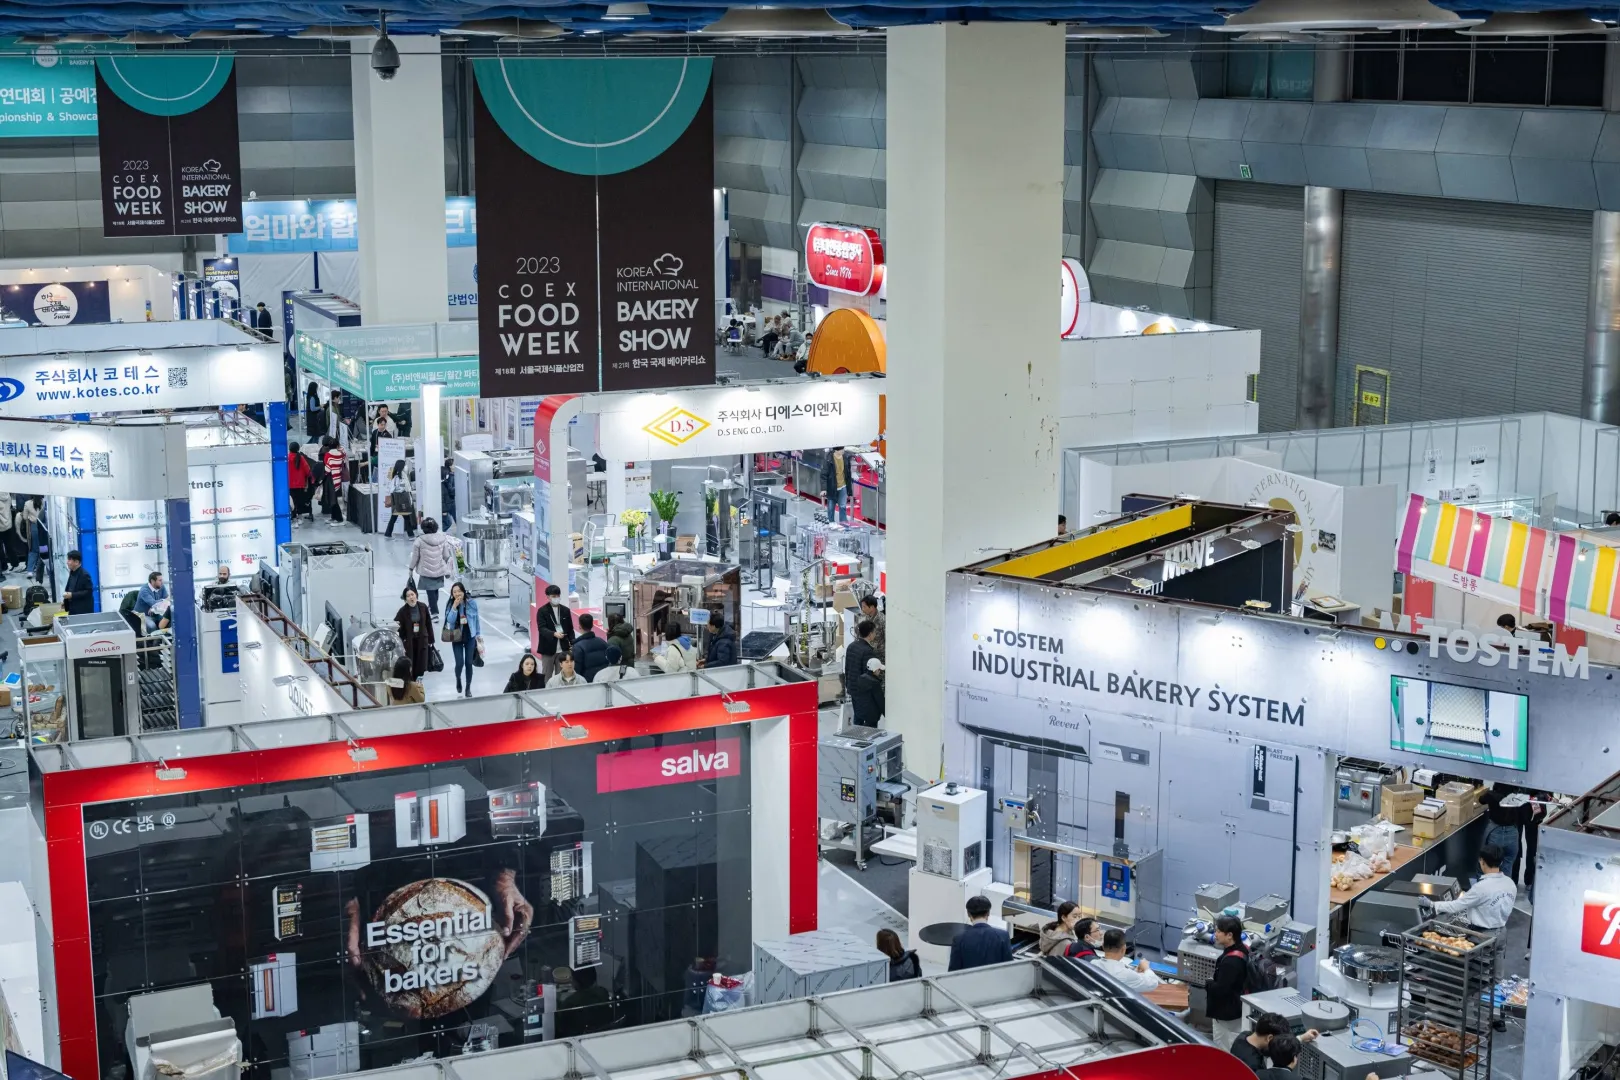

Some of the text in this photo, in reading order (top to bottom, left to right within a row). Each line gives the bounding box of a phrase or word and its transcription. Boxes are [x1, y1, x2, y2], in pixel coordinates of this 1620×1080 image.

[0, 87, 46, 105] 연대회
[46, 112, 55, 121] &
[122, 160, 149, 171] 2023
[113, 175, 159, 183] COEX
[181, 173, 231, 181] INTERNATIONAL
[113, 186, 161, 199] FOOD
[182, 184, 231, 197] BAKERY
[115, 202, 162, 215] WEEK
[184, 201, 227, 214] SHOW
[244, 213, 325, 241] 엄마와
[516, 257, 561, 275] 2023
[616, 267, 654, 278] KOREA
[825, 264, 852, 279] Since 1976
[498, 282, 576, 299] COEX
[616, 279, 699, 292] INTERNATIONAL
[498, 303, 579, 328] FOOD
[617, 298, 699, 322] BAKERY
[499, 331, 580, 357] WEEK
[618, 328, 691, 352] SHOW
[495, 363, 584, 375] 제18회 서울국제식품산업전
[632, 357, 649, 368] 한국
[650, 357, 666, 367] 국제
[667, 355, 706, 366] 베이커리쇼
[35, 367, 98, 386] 주식회사
[36, 384, 160, 401] www.kotes.co.kr
[453, 381, 476, 389] Monthly
[717, 402, 843, 423] 주식회사 디에스이엔지
[670, 419, 694, 433] D.S
[717, 425, 785, 437] D.S ENG CO., LTD.
[189, 480, 224, 490] tners
[1248, 473, 1318, 538] NTERNATIONAL
[993, 628, 1064, 655] TOSTEM
[84, 645, 121, 654] PAVAILLER
[1422, 625, 1590, 681] TOSTEM
[972, 650, 1305, 727] INDUSTRIAL BAKERY SYSTEM
[1049, 715, 1080, 731] Revent
[661, 749, 729, 777] salva
[113, 819, 131, 835] CE
[137, 815, 154, 824] UK
[93, 825, 105, 836] UL
[137, 823, 155, 832] CA
[366, 904, 492, 948] Essential
[411, 939, 452, 965] for
[384, 961, 479, 993] bakers
